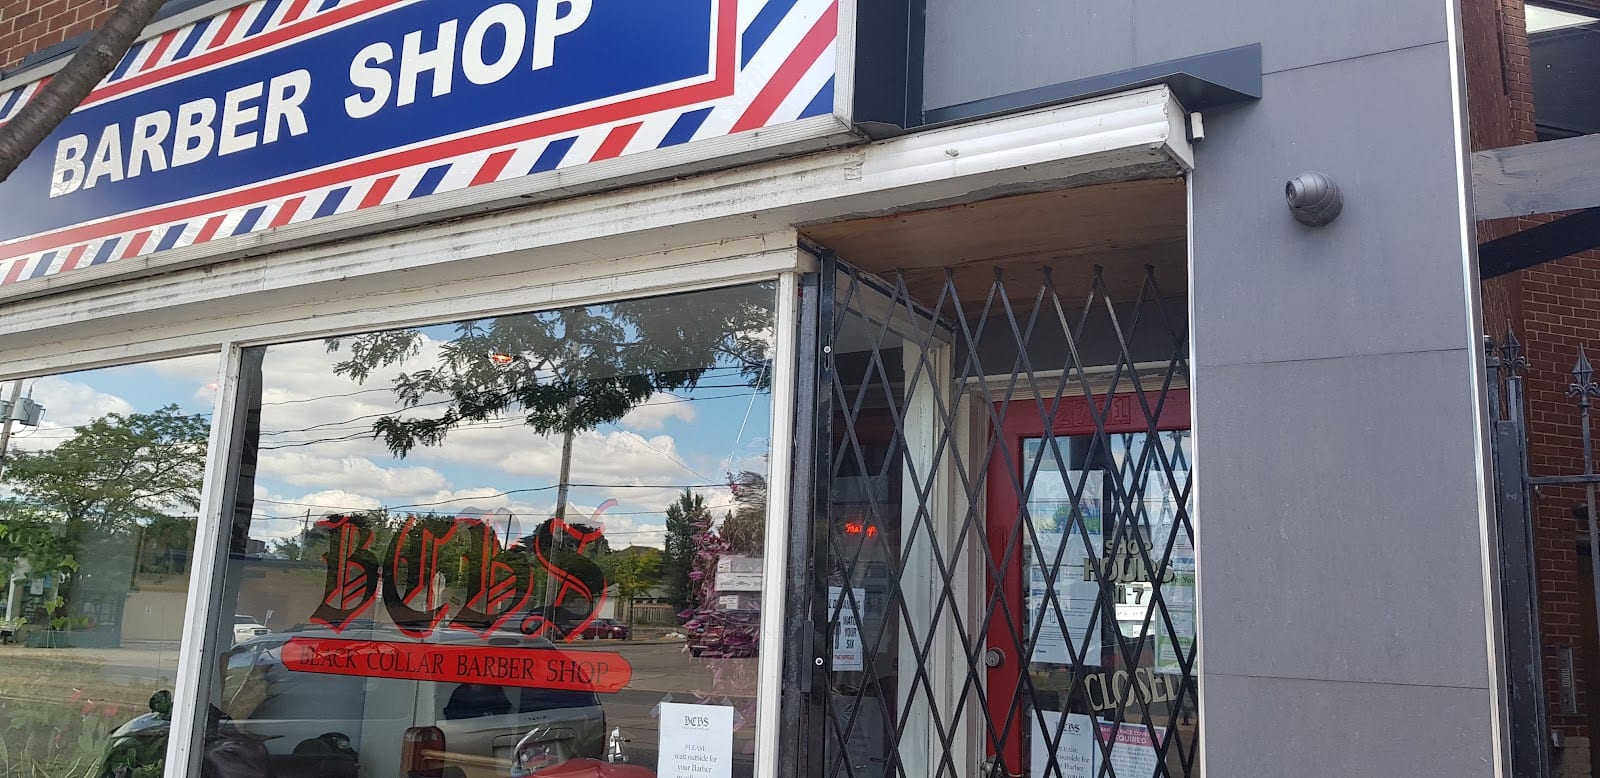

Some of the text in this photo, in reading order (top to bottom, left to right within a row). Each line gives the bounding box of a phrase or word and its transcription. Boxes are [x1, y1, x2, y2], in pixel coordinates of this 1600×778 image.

[49, 0, 593, 198] BARBER SHOP
[310, 498, 618, 643] BCBS
[1083, 558, 1175, 583] HOURS
[299, 645, 609, 686] BLACK COLLAR BARBER SHOP
[683, 715, 710, 727] BCBS
[684, 744, 707, 752] PLEASE
[1115, 735, 1147, 744] EQUIRED
